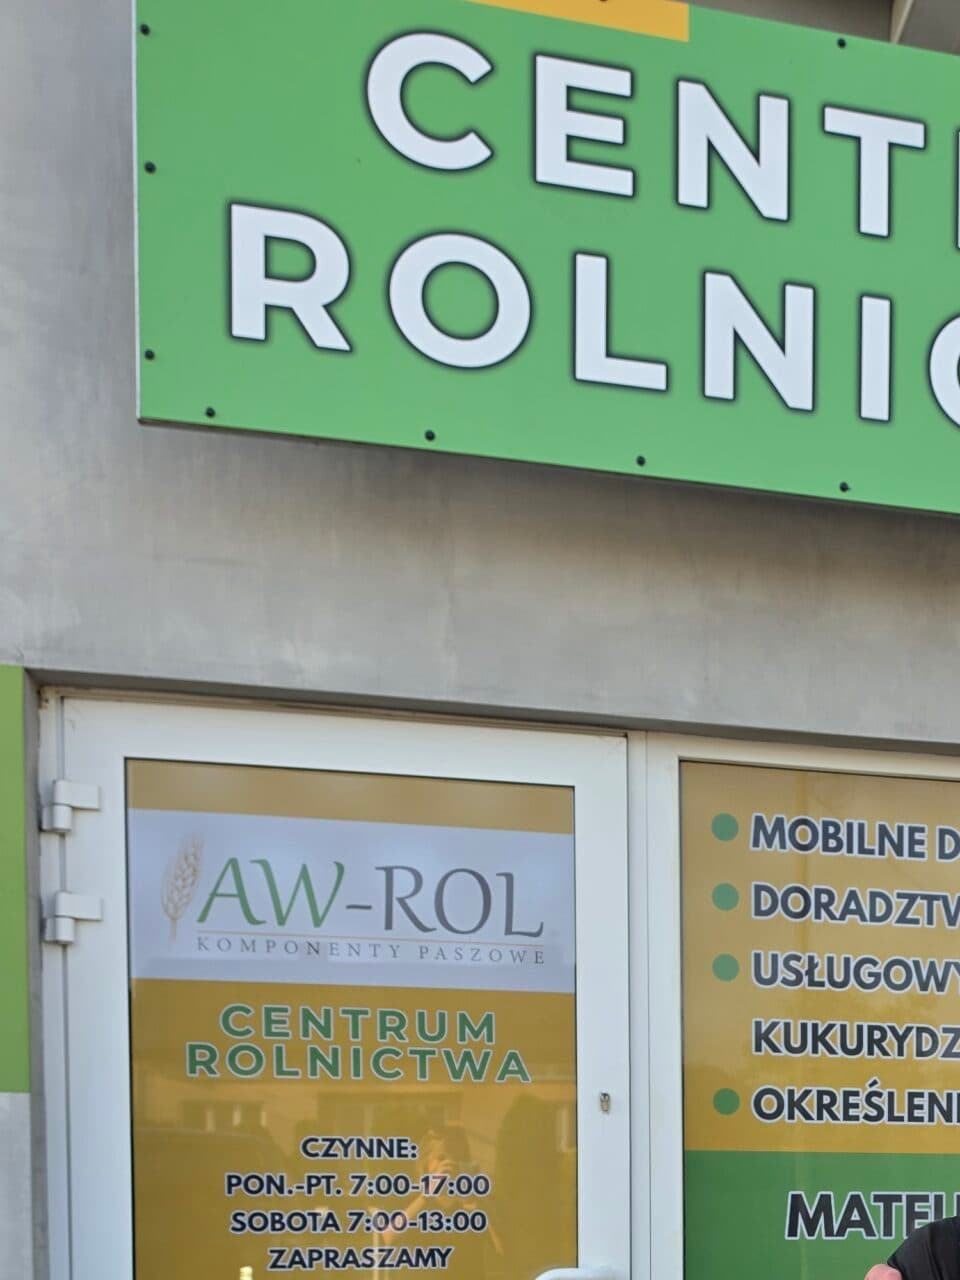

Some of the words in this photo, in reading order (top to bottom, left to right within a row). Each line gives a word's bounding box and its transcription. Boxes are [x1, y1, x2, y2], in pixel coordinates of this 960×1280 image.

[751, 814, 927, 861] MOBILNE
[197, 856, 544, 938] AW-ROL
[197, 936, 401, 960] KOMPONENTY
[418, 944, 545, 965] PASZOWE
[219, 1003, 496, 1045] CENTRUM
[186, 1042, 532, 1083] ROLNICTWA
[300, 1137, 419, 1160] CZYNNE:
[225, 1173, 342, 1197] PON.-PT.
[349, 1173, 491, 1197] 7:00-17:00
[230, 1211, 339, 1234] SOBOTA
[347, 1211, 488, 1234] 7:00-13:00
[266, 1246, 454, 1271] ZAPRASZAMY
